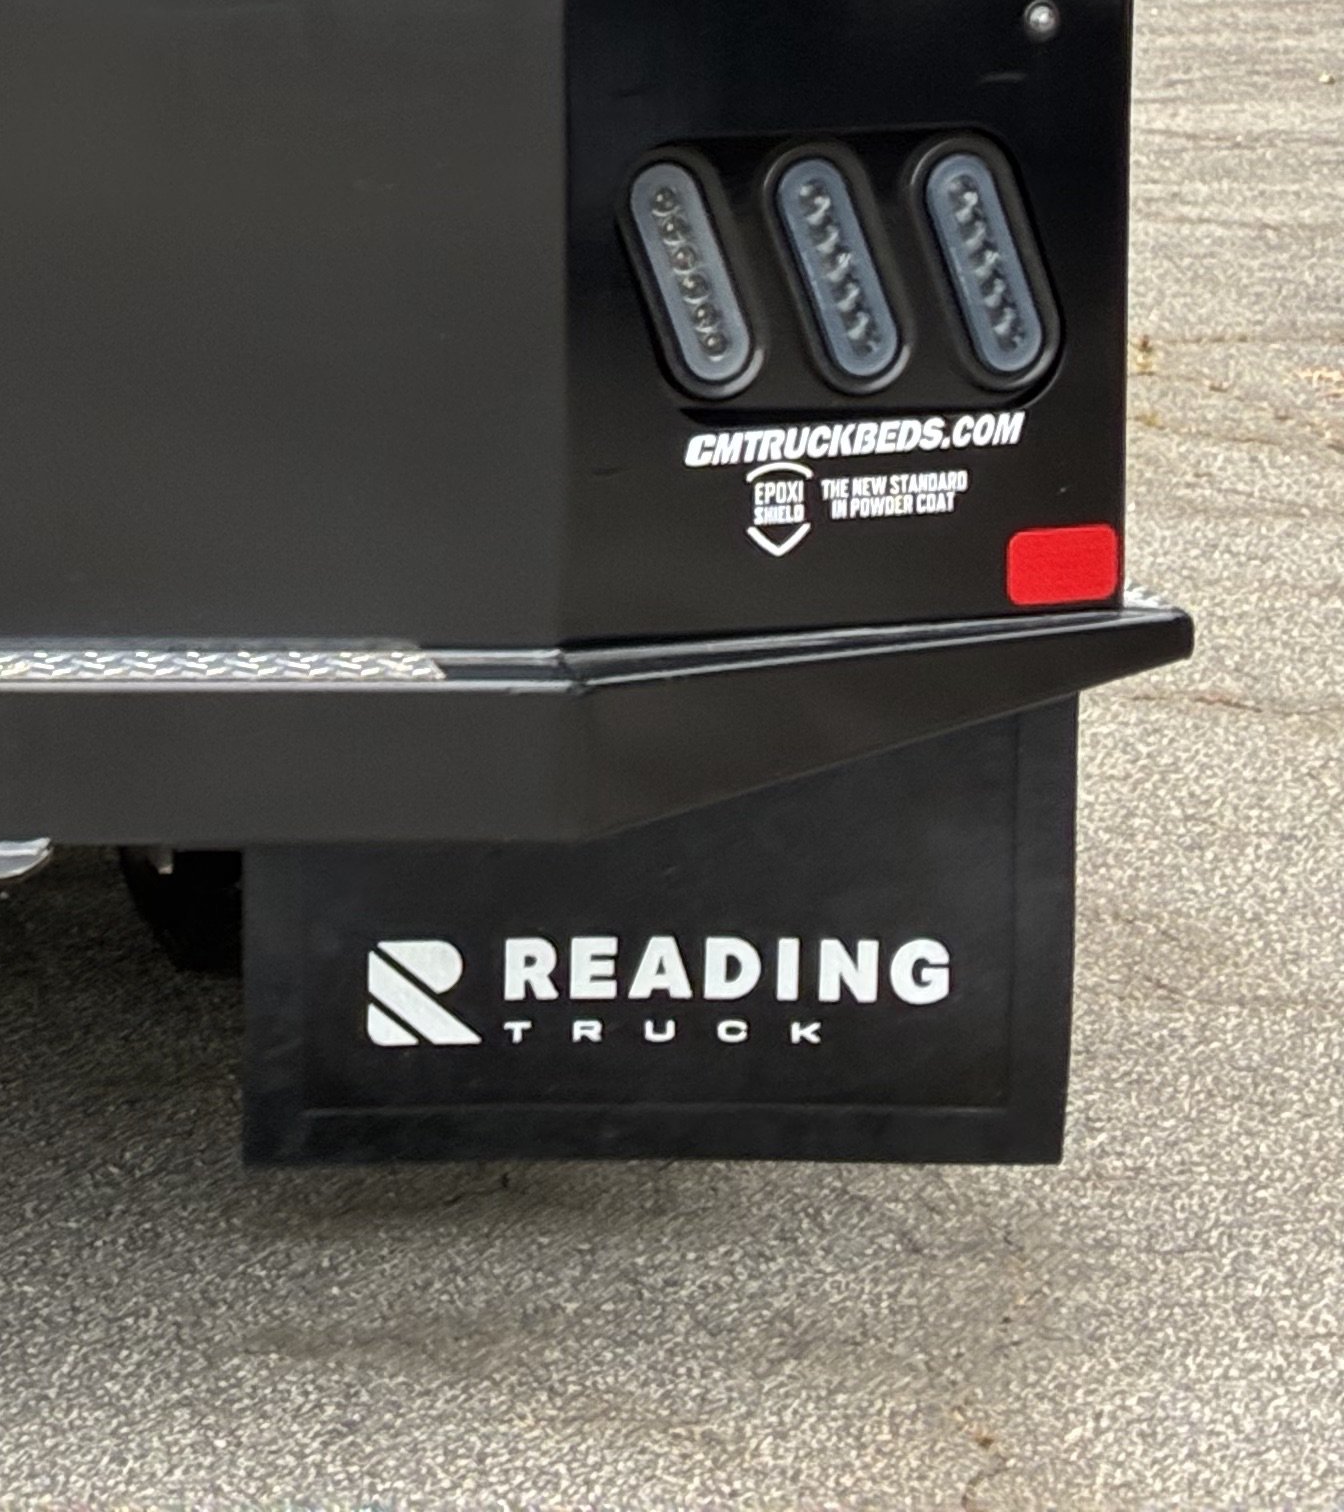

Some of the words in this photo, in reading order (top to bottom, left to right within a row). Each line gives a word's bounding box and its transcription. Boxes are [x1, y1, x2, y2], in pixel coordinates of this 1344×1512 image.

[685, 411, 1025, 468] CMTRUCKBEDS.COM
[754, 480, 804, 506] EPOXI
[820, 477, 850, 500] THE
[851, 475, 888, 497] NEW
[889, 470, 968, 495] STANDARD
[753, 505, 805, 525] SHIELD
[831, 498, 848, 520] IN
[850, 493, 913, 519] POWDER
[916, 491, 956, 513] COAT
[503, 935, 950, 1005] READING
[503, 1019, 821, 1044] TRUCK
